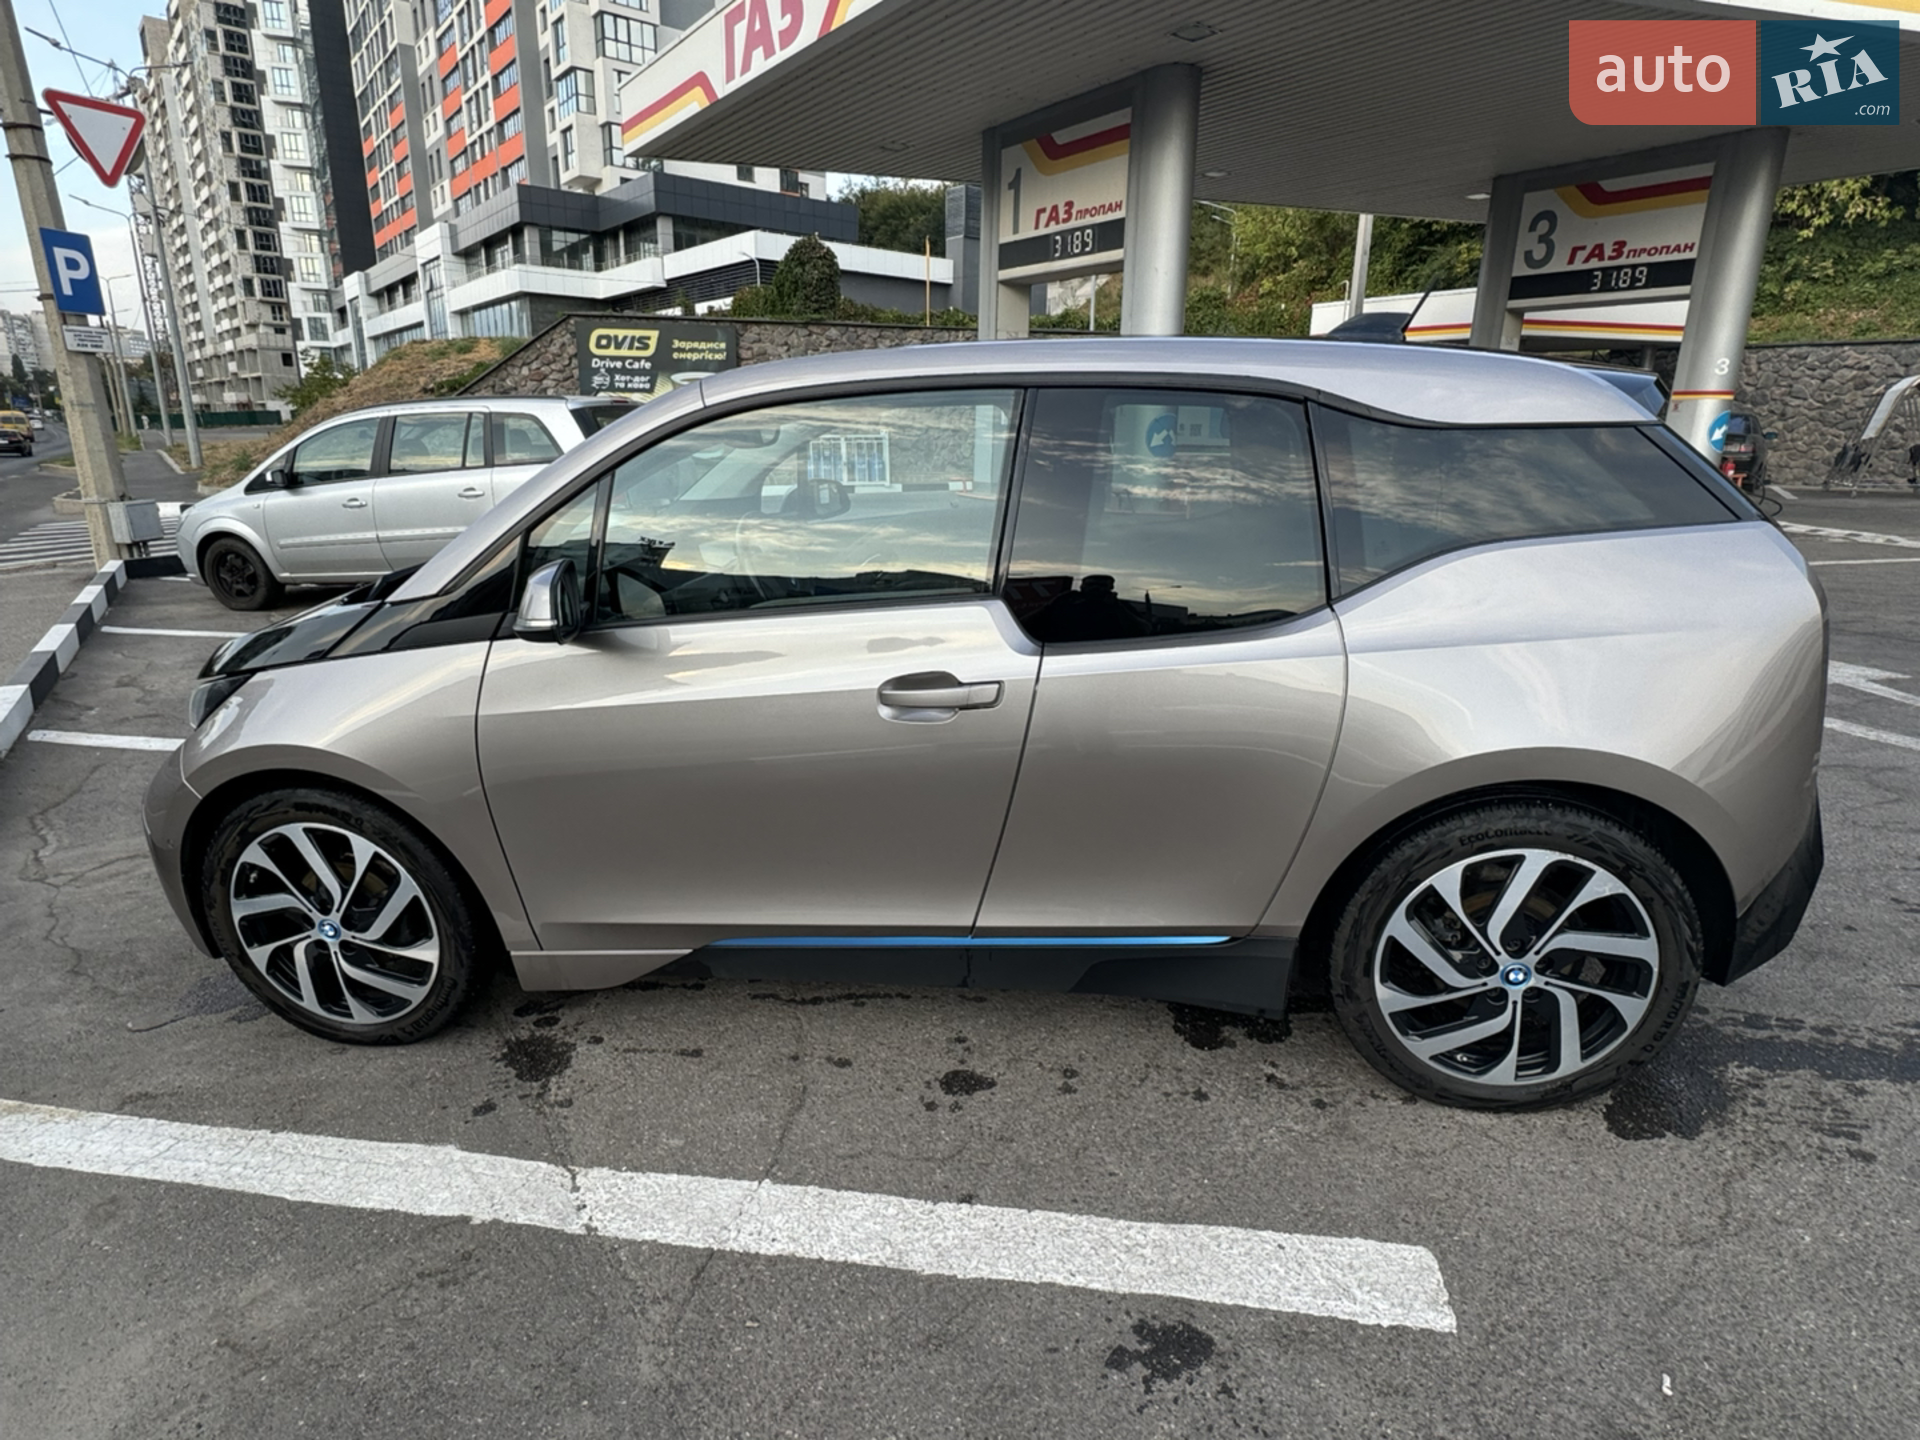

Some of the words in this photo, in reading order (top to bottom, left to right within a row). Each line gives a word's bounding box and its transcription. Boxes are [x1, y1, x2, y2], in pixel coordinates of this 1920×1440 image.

[724, 0, 804, 85] ГАЗ
[1008, 167, 1022, 235] 1
[1034, 200, 1075, 230] ГАЗ
[1075, 200, 1123, 221] ПРОПАН
[1523, 209, 1558, 270] 3
[1566, 240, 1628, 266] ГАЗ
[1625, 242, 1696, 260] ПРОПАН
[52, 246, 91, 296] P
[595, 334, 651, 351] OVIS
[671, 339, 727, 351] Зарядися
[591, 358, 623, 369] Drive
[624, 358, 652, 370] Cafe
[1714, 357, 1730, 376] 3
